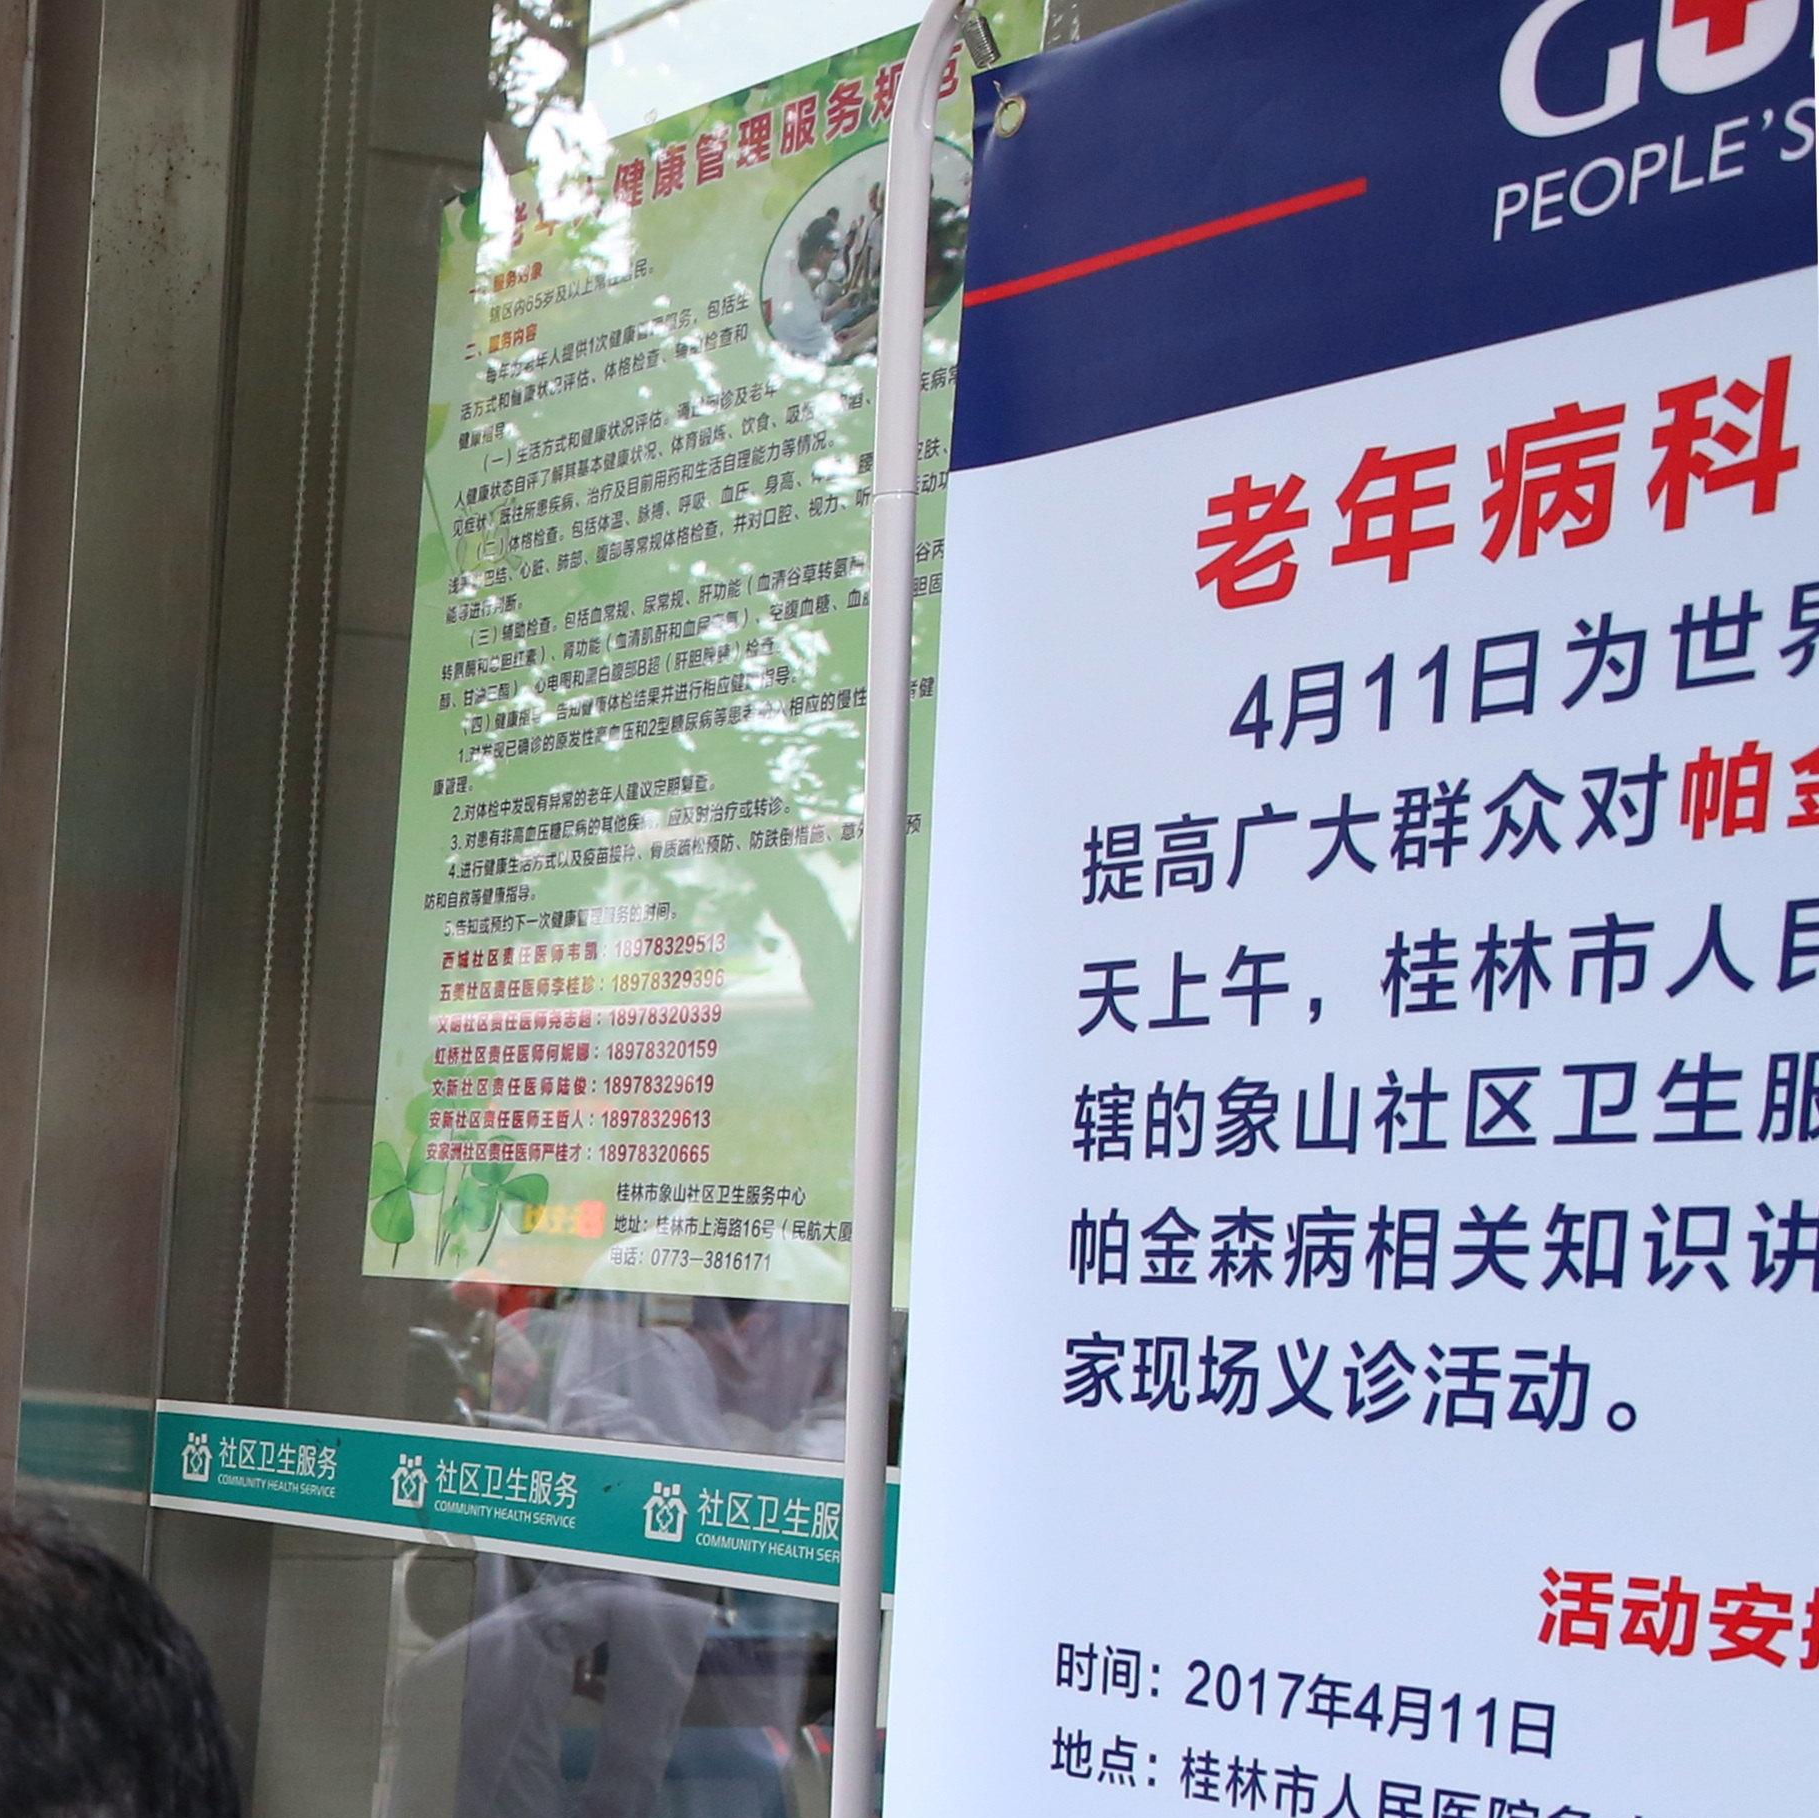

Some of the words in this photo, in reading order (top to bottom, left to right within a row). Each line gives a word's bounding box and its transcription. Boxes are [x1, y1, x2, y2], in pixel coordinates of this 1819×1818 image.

[1499, 0, 1815, 138] GU
[1493, 97, 1816, 242] PEOPLE'S
[1195, 354, 1801, 611] 老年病科
[1071, 1050, 1819, 1162] 辖的象山社区卫生服
[616, 1181, 806, 1207] 桂林市象山社区卫生服务中心
[1068, 1199, 1819, 1294] 帕金森病相关知识讲
[1061, 1331, 1638, 1433] 家现场义诊活动。
[217, 1473, 266, 1489] COMMUNITY
[267, 1479, 300, 1494] HEALTH
[300, 1483, 336, 1498] SERVICE
[218, 1435, 339, 1481] 社区卫生服务
[435, 1458, 579, 1509] 社区卫生服务
[434, 1499, 493, 1518] COMMUNITY
[493, 1506, 532, 1523] HEALTH
[532, 1512, 576, 1529] SERVICE
[695, 1532, 766, 1554] COMMUNITY
[767, 1540, 814, 1560] HEALTH
[696, 1487, 842, 1541] 社区卫生服
[1538, 1566, 1819, 1670] 活动安
